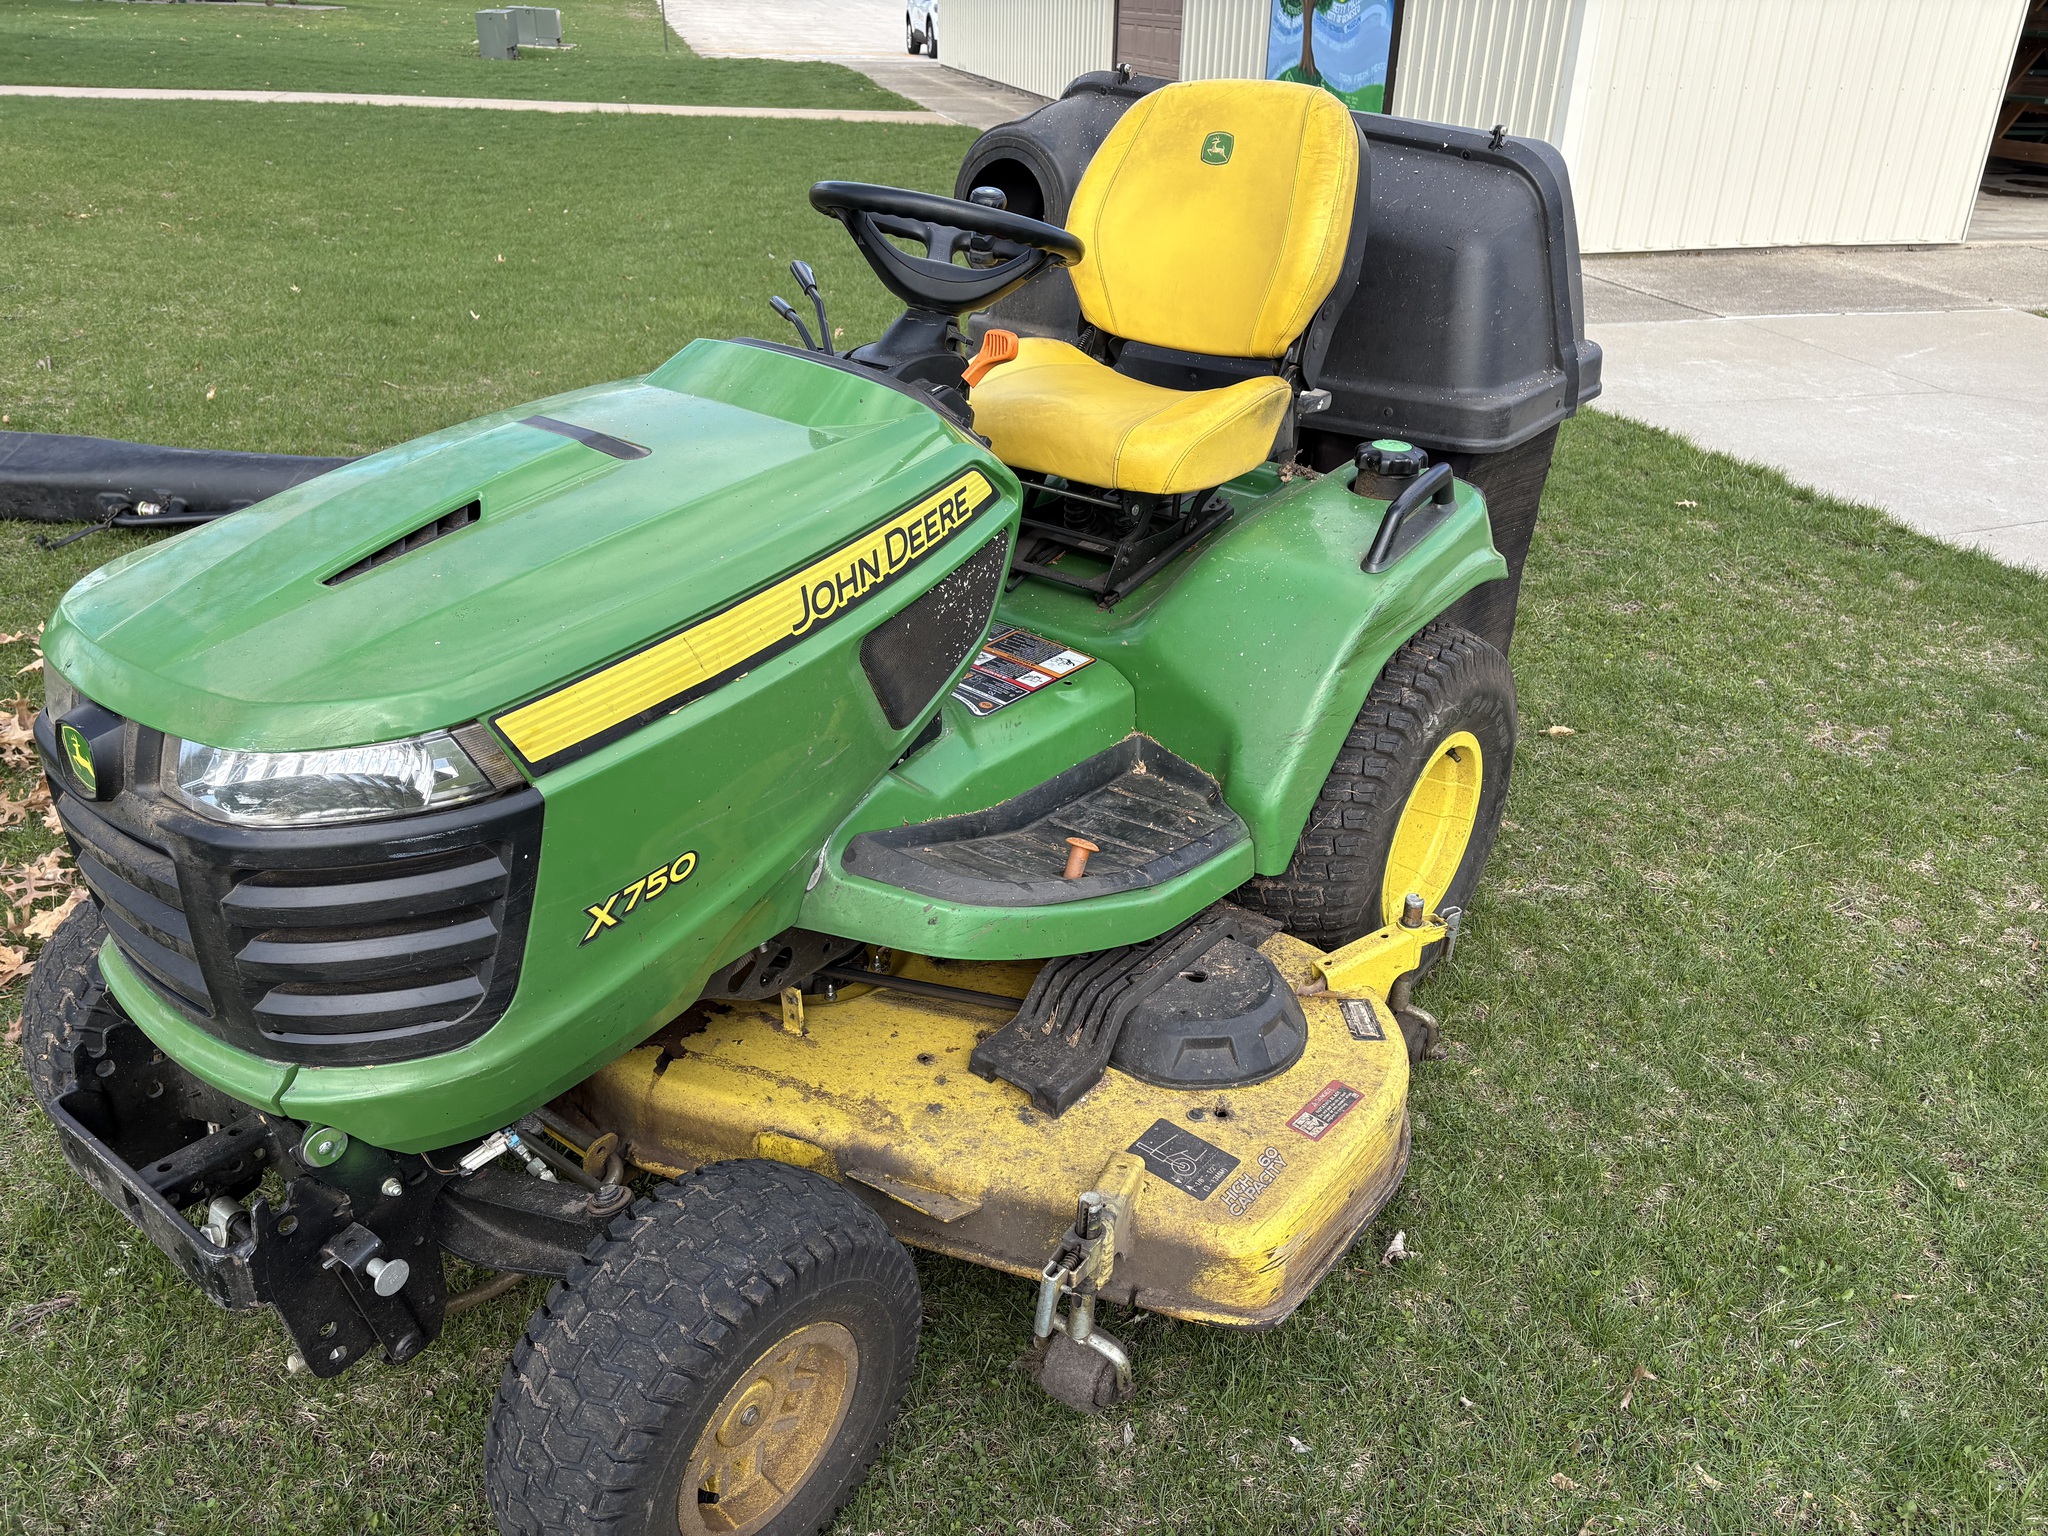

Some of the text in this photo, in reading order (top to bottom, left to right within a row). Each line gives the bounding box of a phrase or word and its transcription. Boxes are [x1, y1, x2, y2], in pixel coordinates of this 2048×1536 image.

[793, 485, 970, 632] JOHN DEERE
[578, 850, 699, 946] X750
[1228, 1153, 1288, 1217] CAPACITY
[1256, 1146, 1279, 1168] 60
[1219, 1172, 1255, 1207] HIGH
